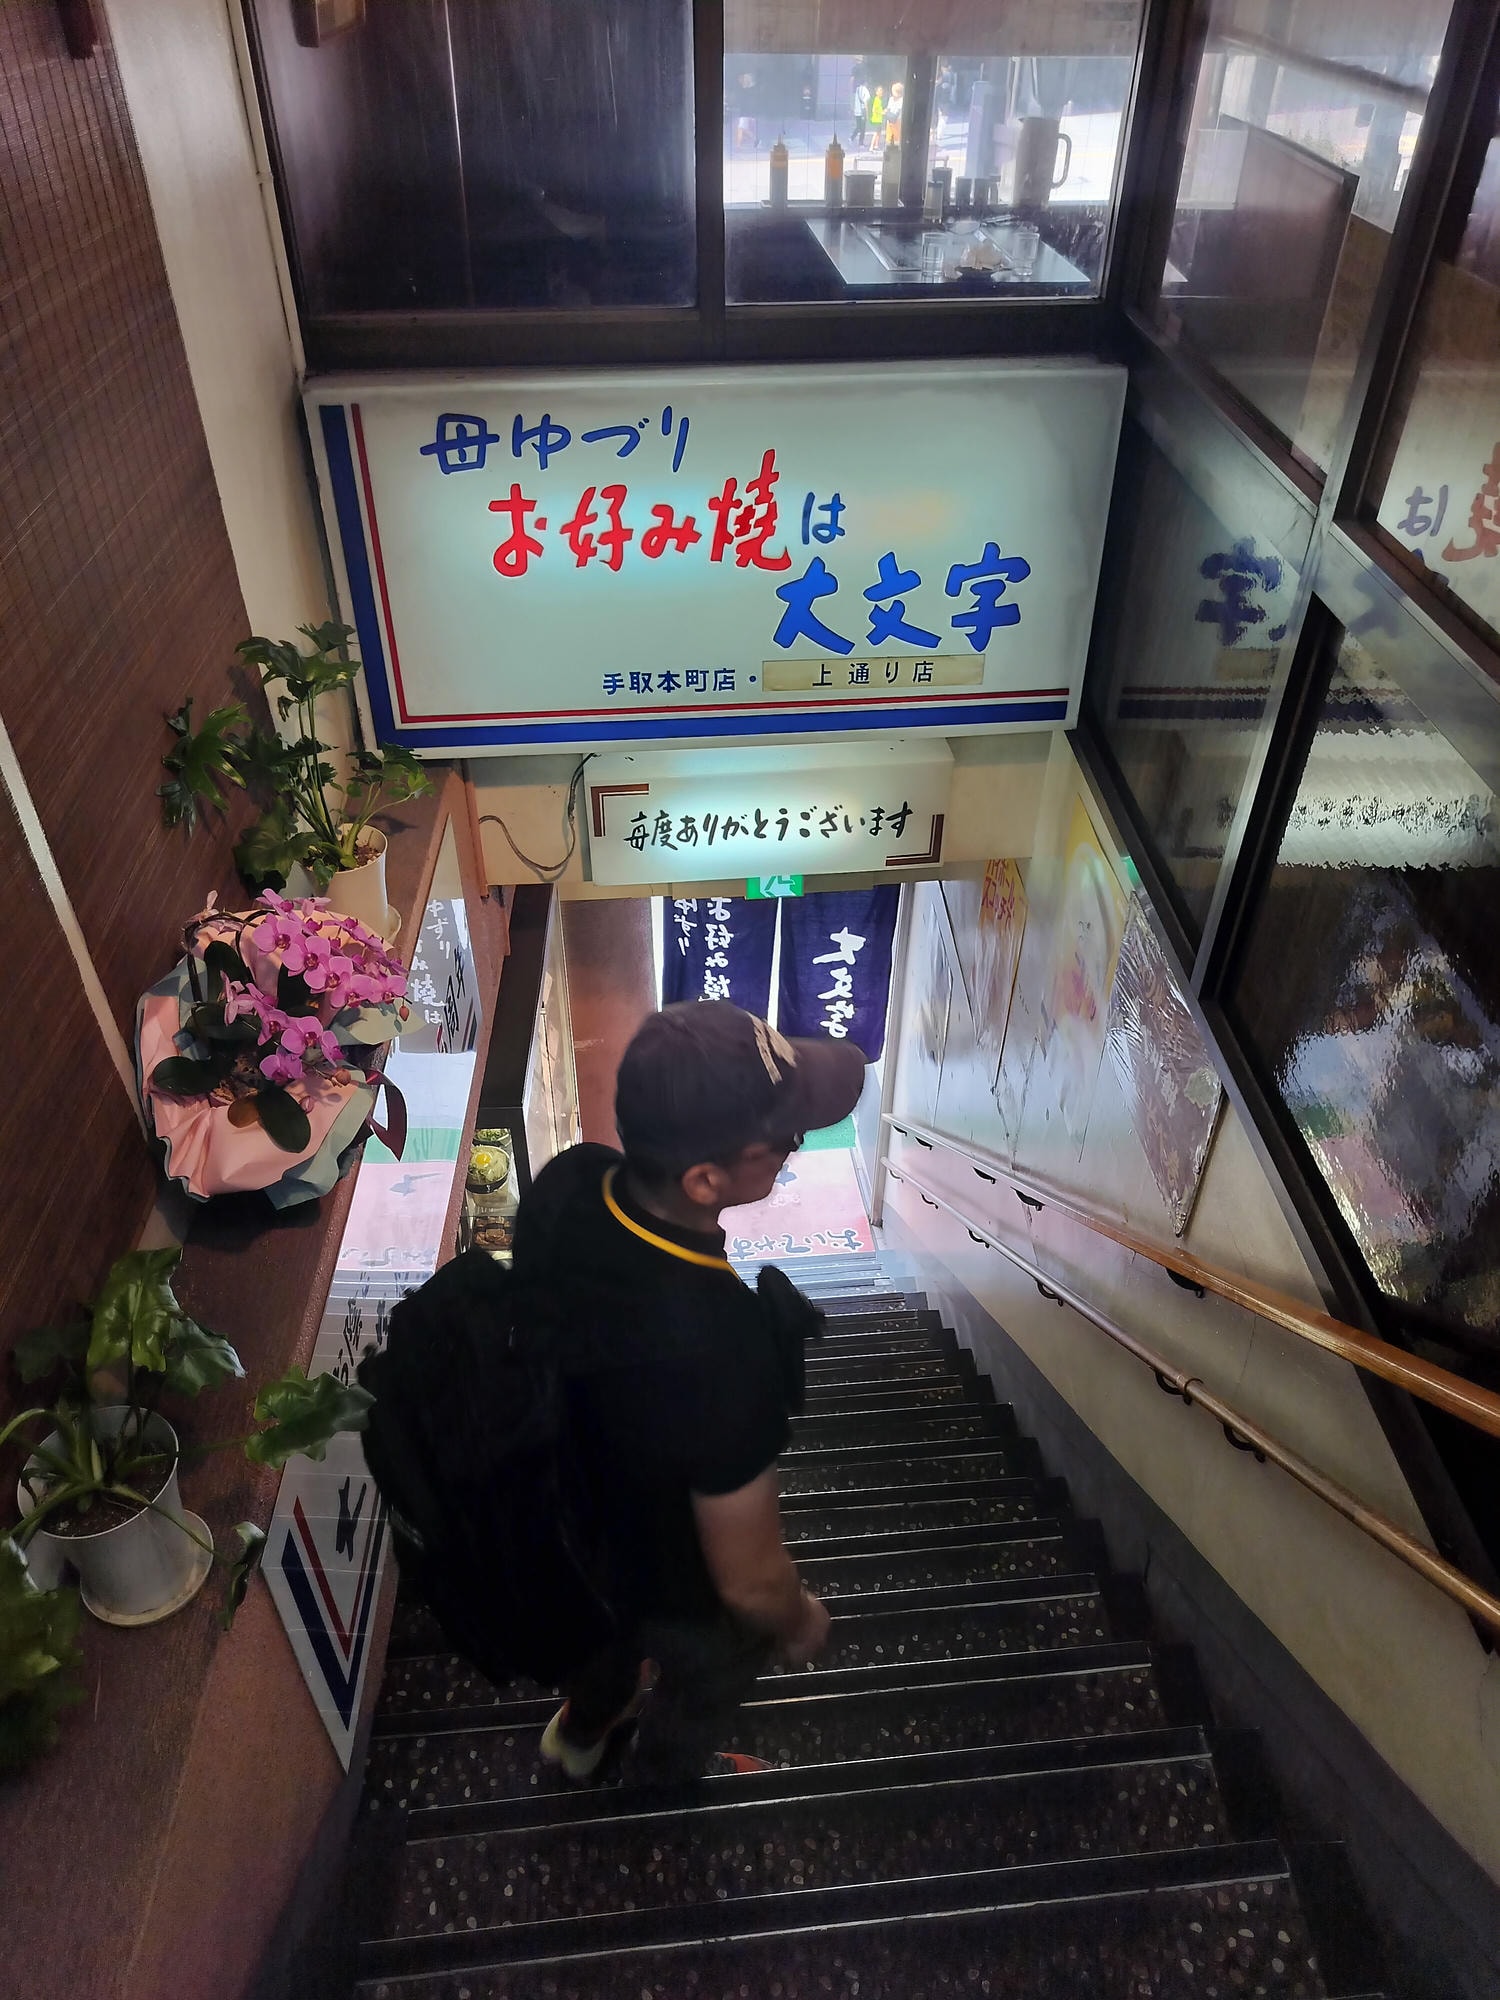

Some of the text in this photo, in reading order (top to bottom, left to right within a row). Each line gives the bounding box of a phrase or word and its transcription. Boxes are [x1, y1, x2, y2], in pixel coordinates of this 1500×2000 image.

[772, 542, 1031, 654] 大文字
[812, 659, 936, 687] 上通り店
[623, 800, 914, 853] 毎度ありがとうございます
